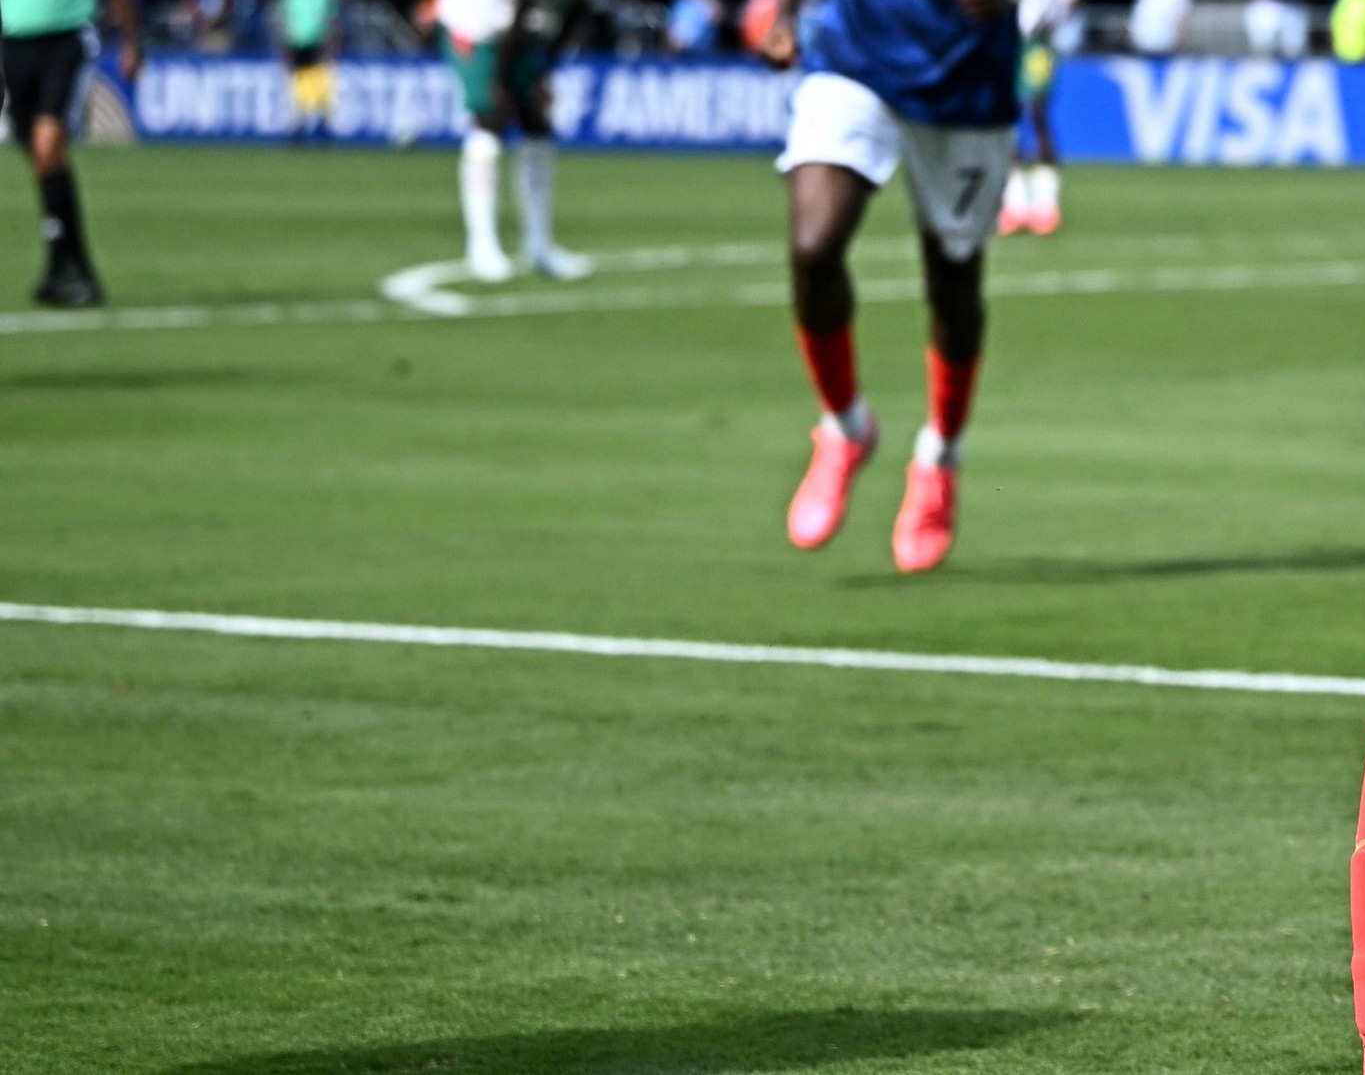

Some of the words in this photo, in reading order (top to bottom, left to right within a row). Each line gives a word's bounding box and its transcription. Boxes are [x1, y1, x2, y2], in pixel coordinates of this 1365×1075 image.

[137, 61, 294, 134] UNITE
[1104, 56, 1350, 166] VISA
[952, 165, 987, 220] 7
